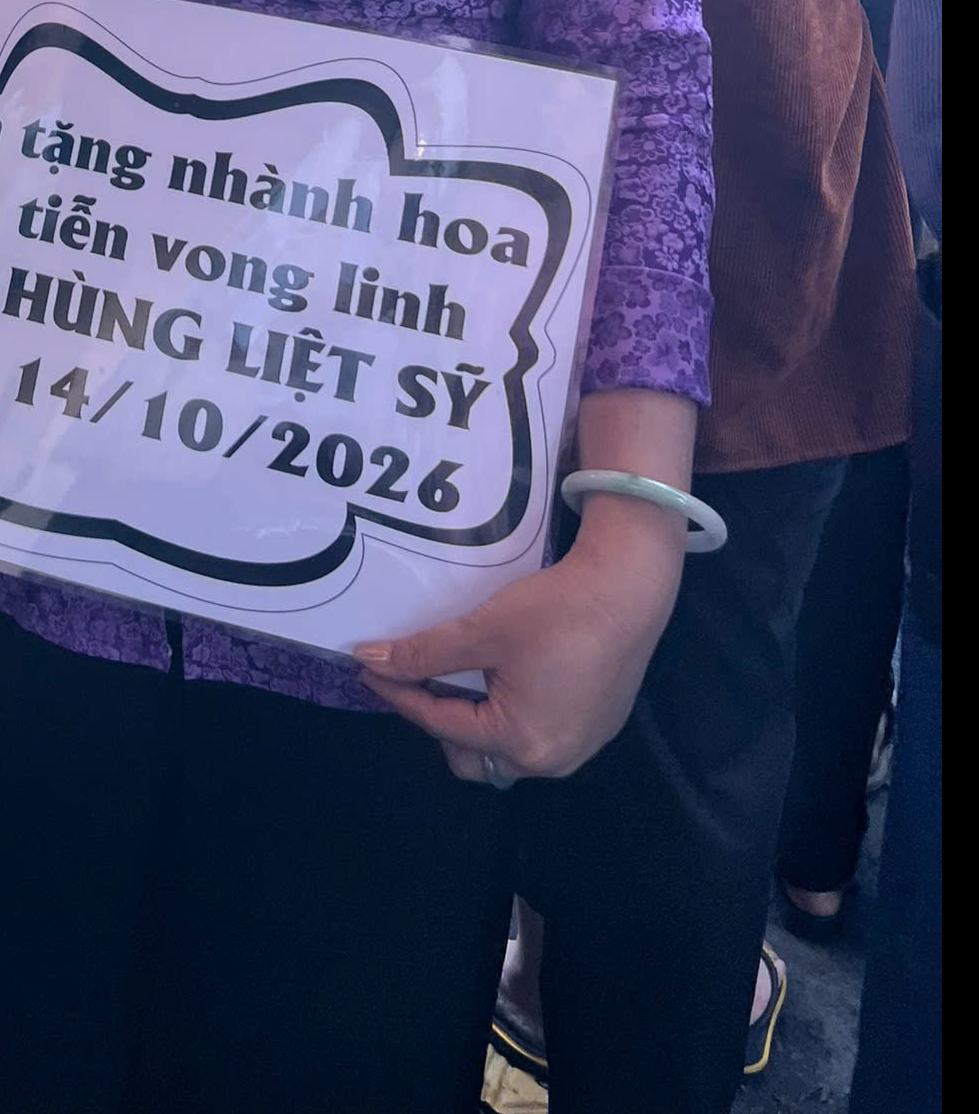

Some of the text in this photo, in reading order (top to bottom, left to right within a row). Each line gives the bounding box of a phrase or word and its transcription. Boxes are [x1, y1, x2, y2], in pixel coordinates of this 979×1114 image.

[18, 194, 129, 262] tiễn
[151, 233, 315, 313] vong
[333, 261, 466, 341] linh
[21, 119, 153, 191] tặng
[167, 151, 373, 234] nhành
[396, 192, 530, 268] hoa
[1, 266, 204, 361] HÙNG
[225, 321, 376, 403] LIỆT
[395, 362, 492, 430] SỸ
[14, 357, 464, 513] 14/10/2026
